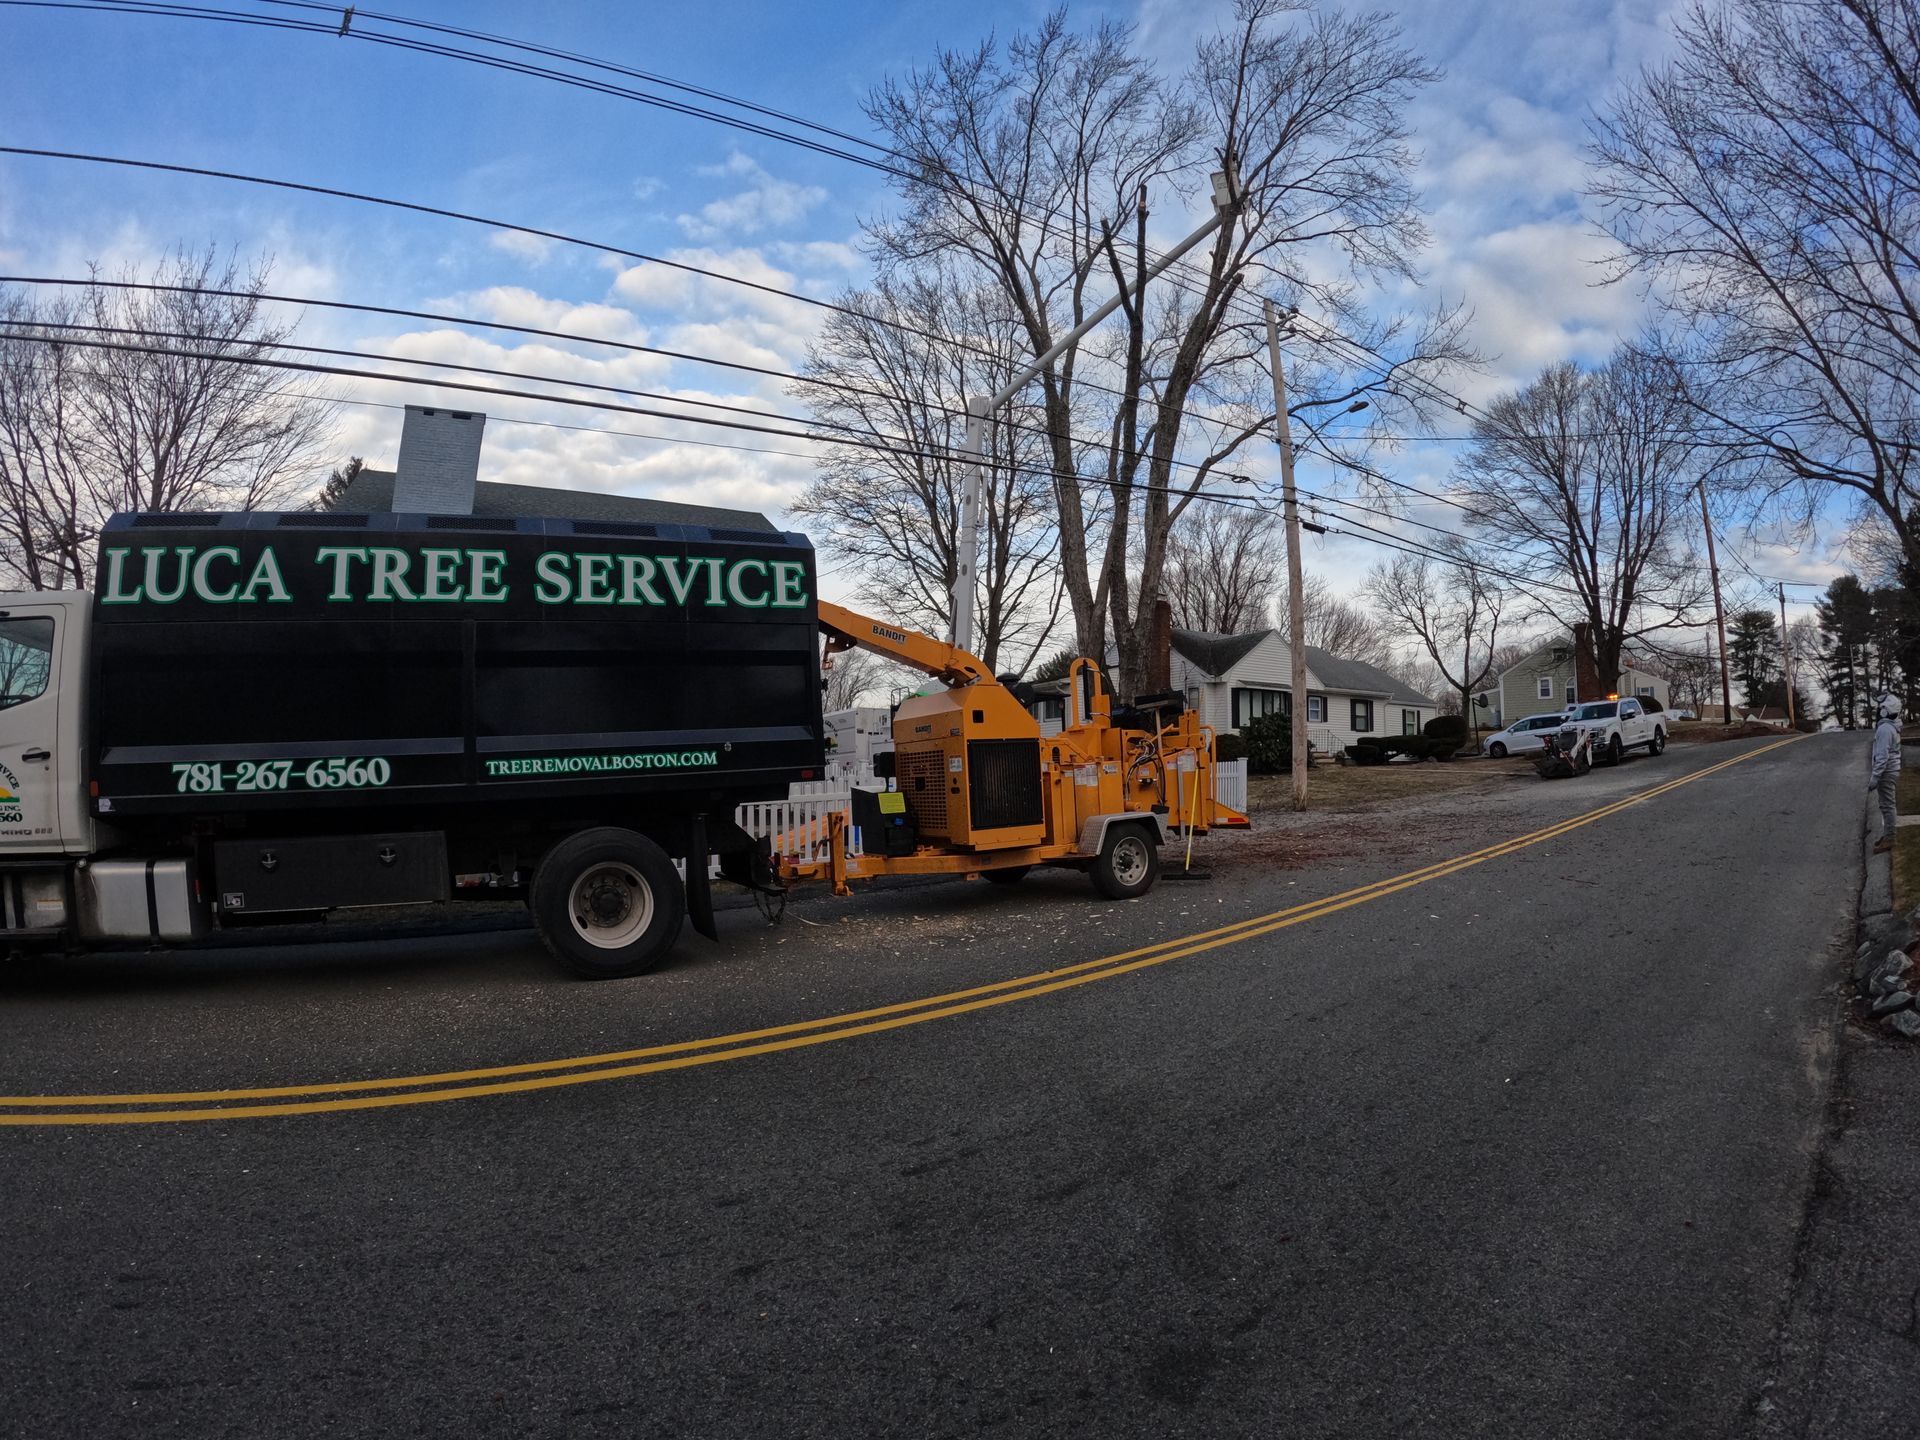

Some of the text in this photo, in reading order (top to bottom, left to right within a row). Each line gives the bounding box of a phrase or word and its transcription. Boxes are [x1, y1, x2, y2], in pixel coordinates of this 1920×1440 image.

[101, 545, 809, 609] LUCA TREE SERVICE
[872, 624, 906, 642] BANDIT
[171, 757, 391, 793] 781-267-6560
[486, 751, 719, 776] TREEREMOVALBOSTON.COM
